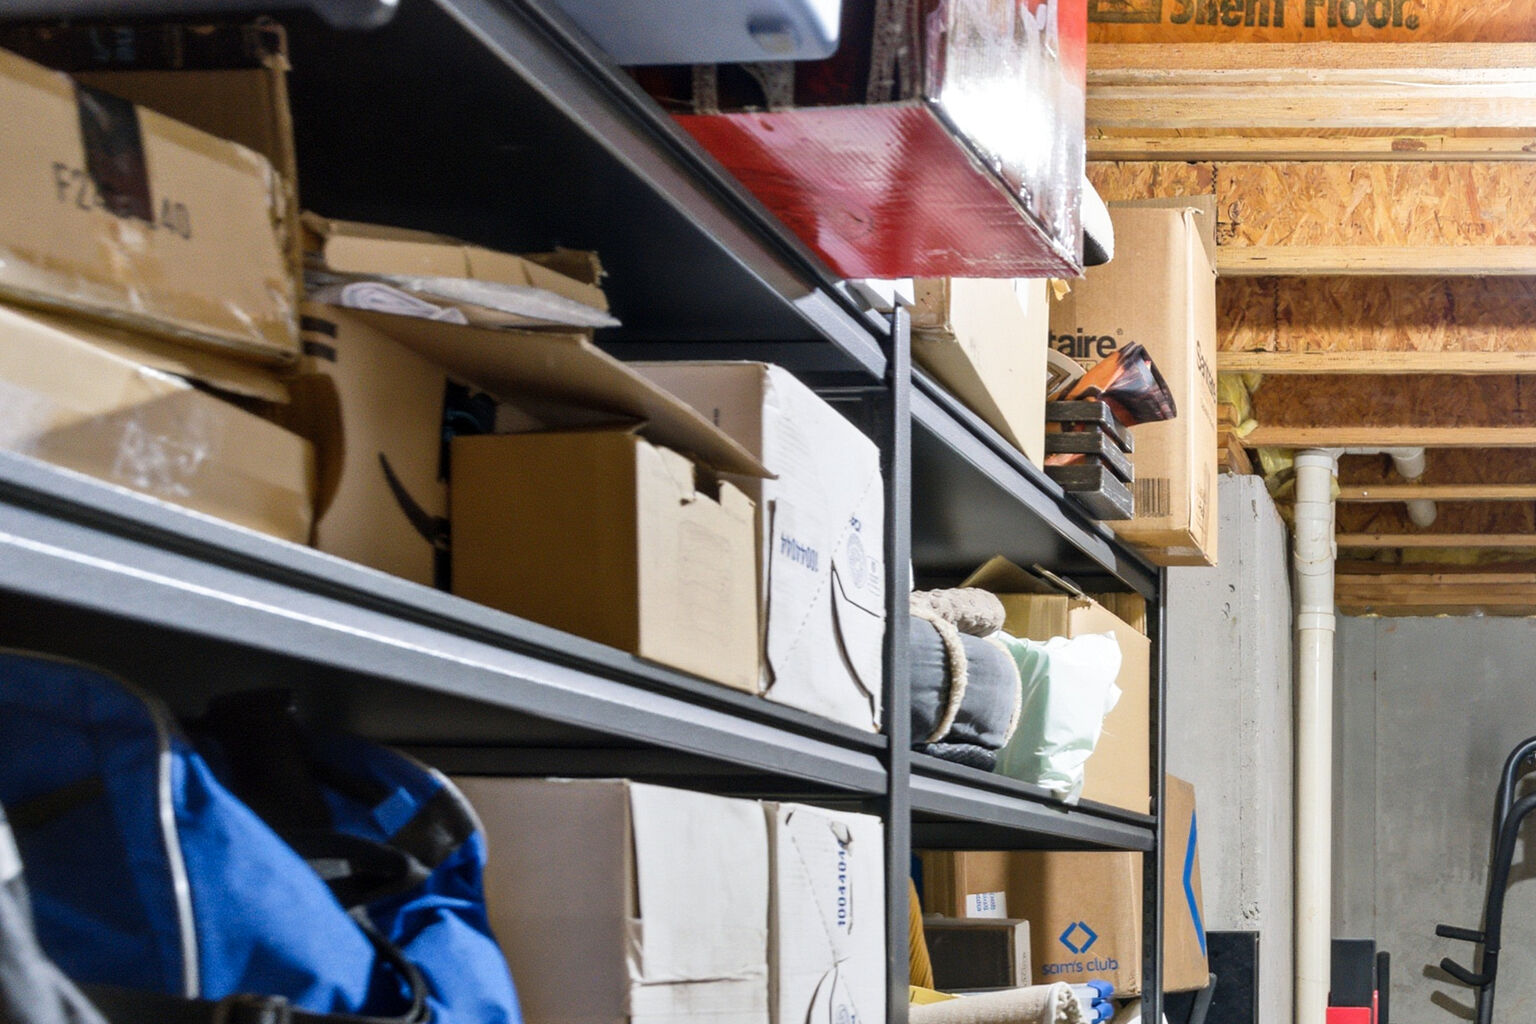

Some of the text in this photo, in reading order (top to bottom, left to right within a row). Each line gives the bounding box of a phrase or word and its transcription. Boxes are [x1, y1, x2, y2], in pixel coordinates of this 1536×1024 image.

[1049, 327, 1117, 358] taire
[837, 842, 847, 926] 1004404
[1086, 957, 1119, 972] club
